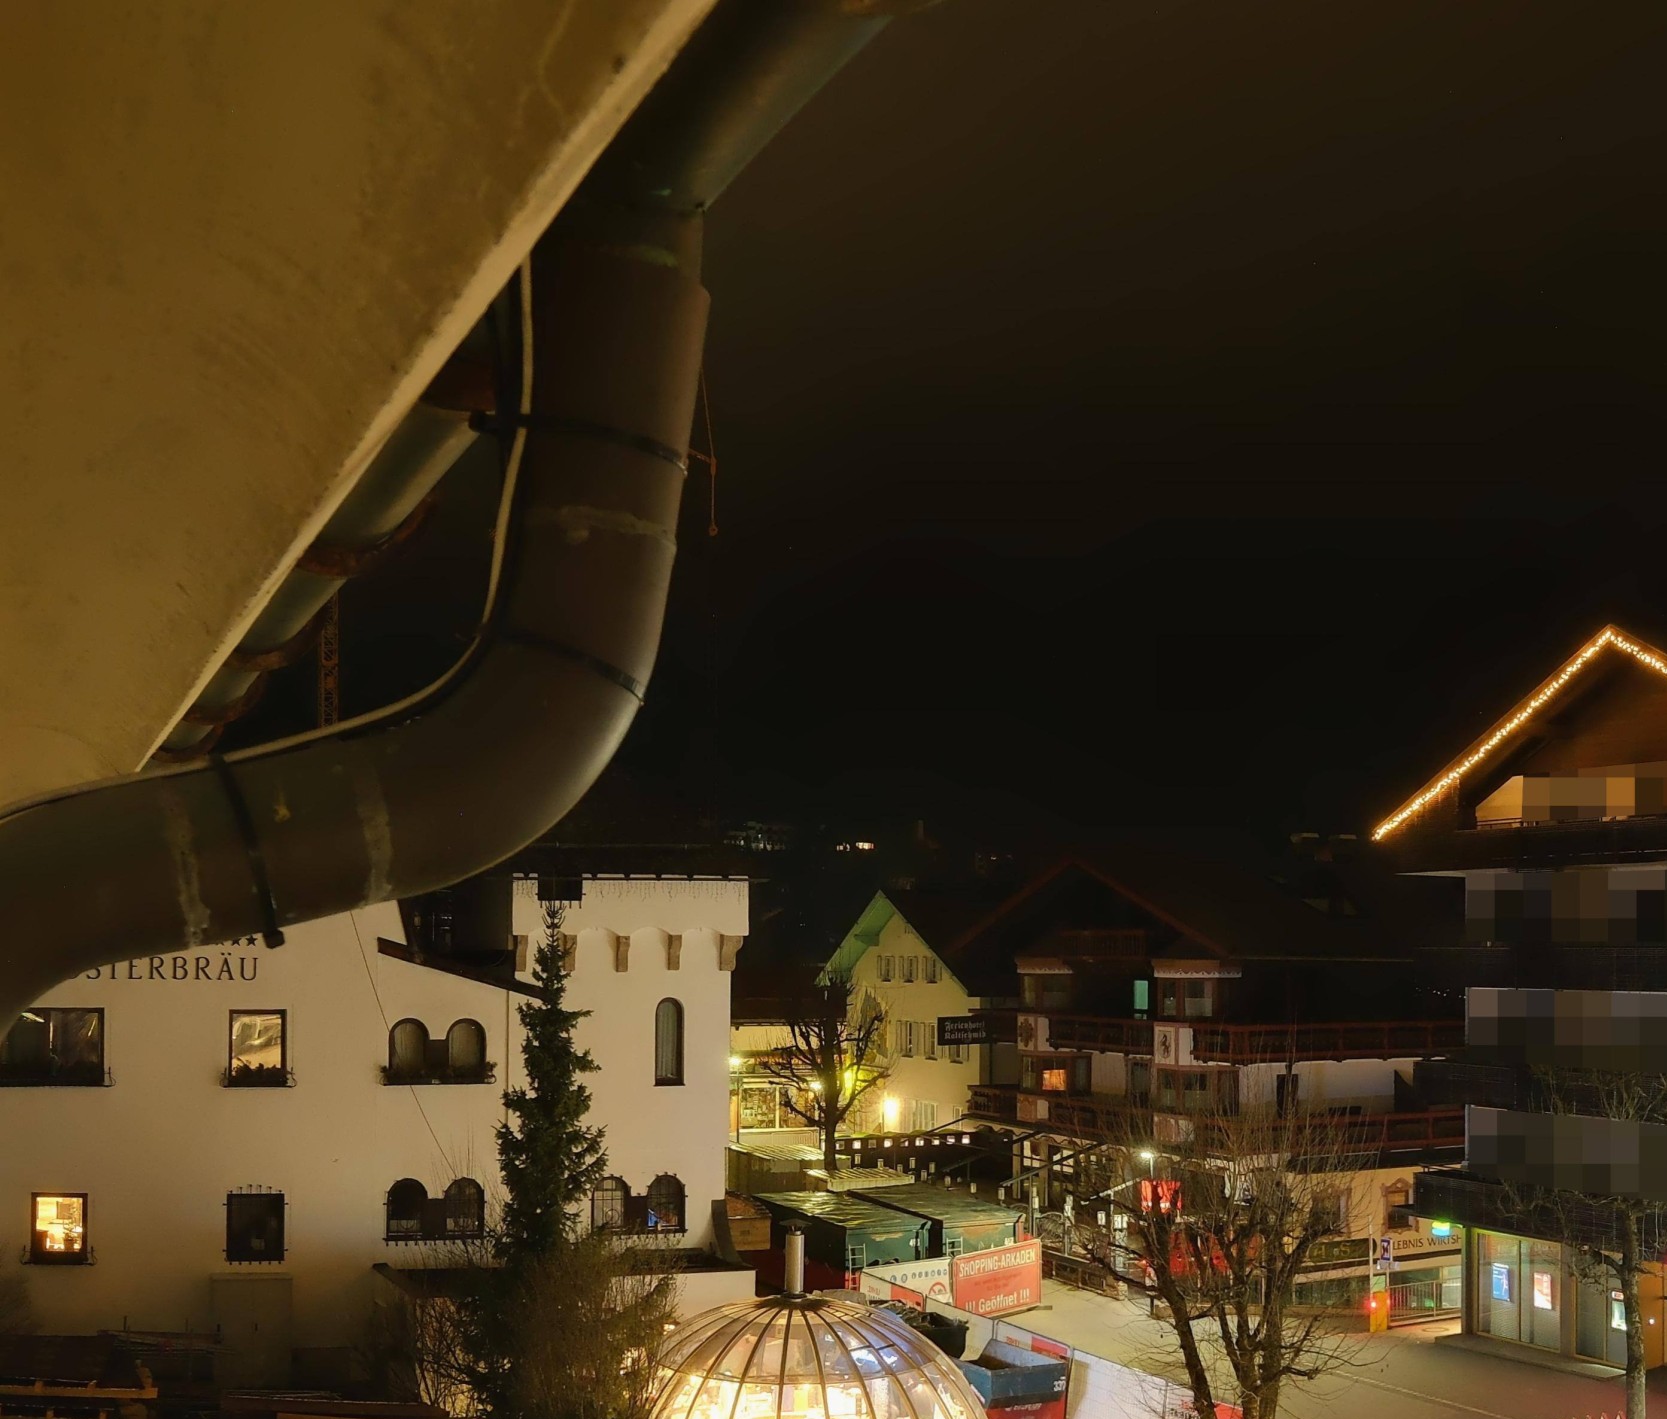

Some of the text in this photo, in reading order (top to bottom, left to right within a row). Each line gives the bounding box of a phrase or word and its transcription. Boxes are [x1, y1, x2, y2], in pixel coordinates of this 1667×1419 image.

[68, 952, 258, 981] STERBRÄU
[959, 1248, 1036, 1277] SHOPPING-ARKADEN
[978, 1293, 1017, 1313] Geöffnet
